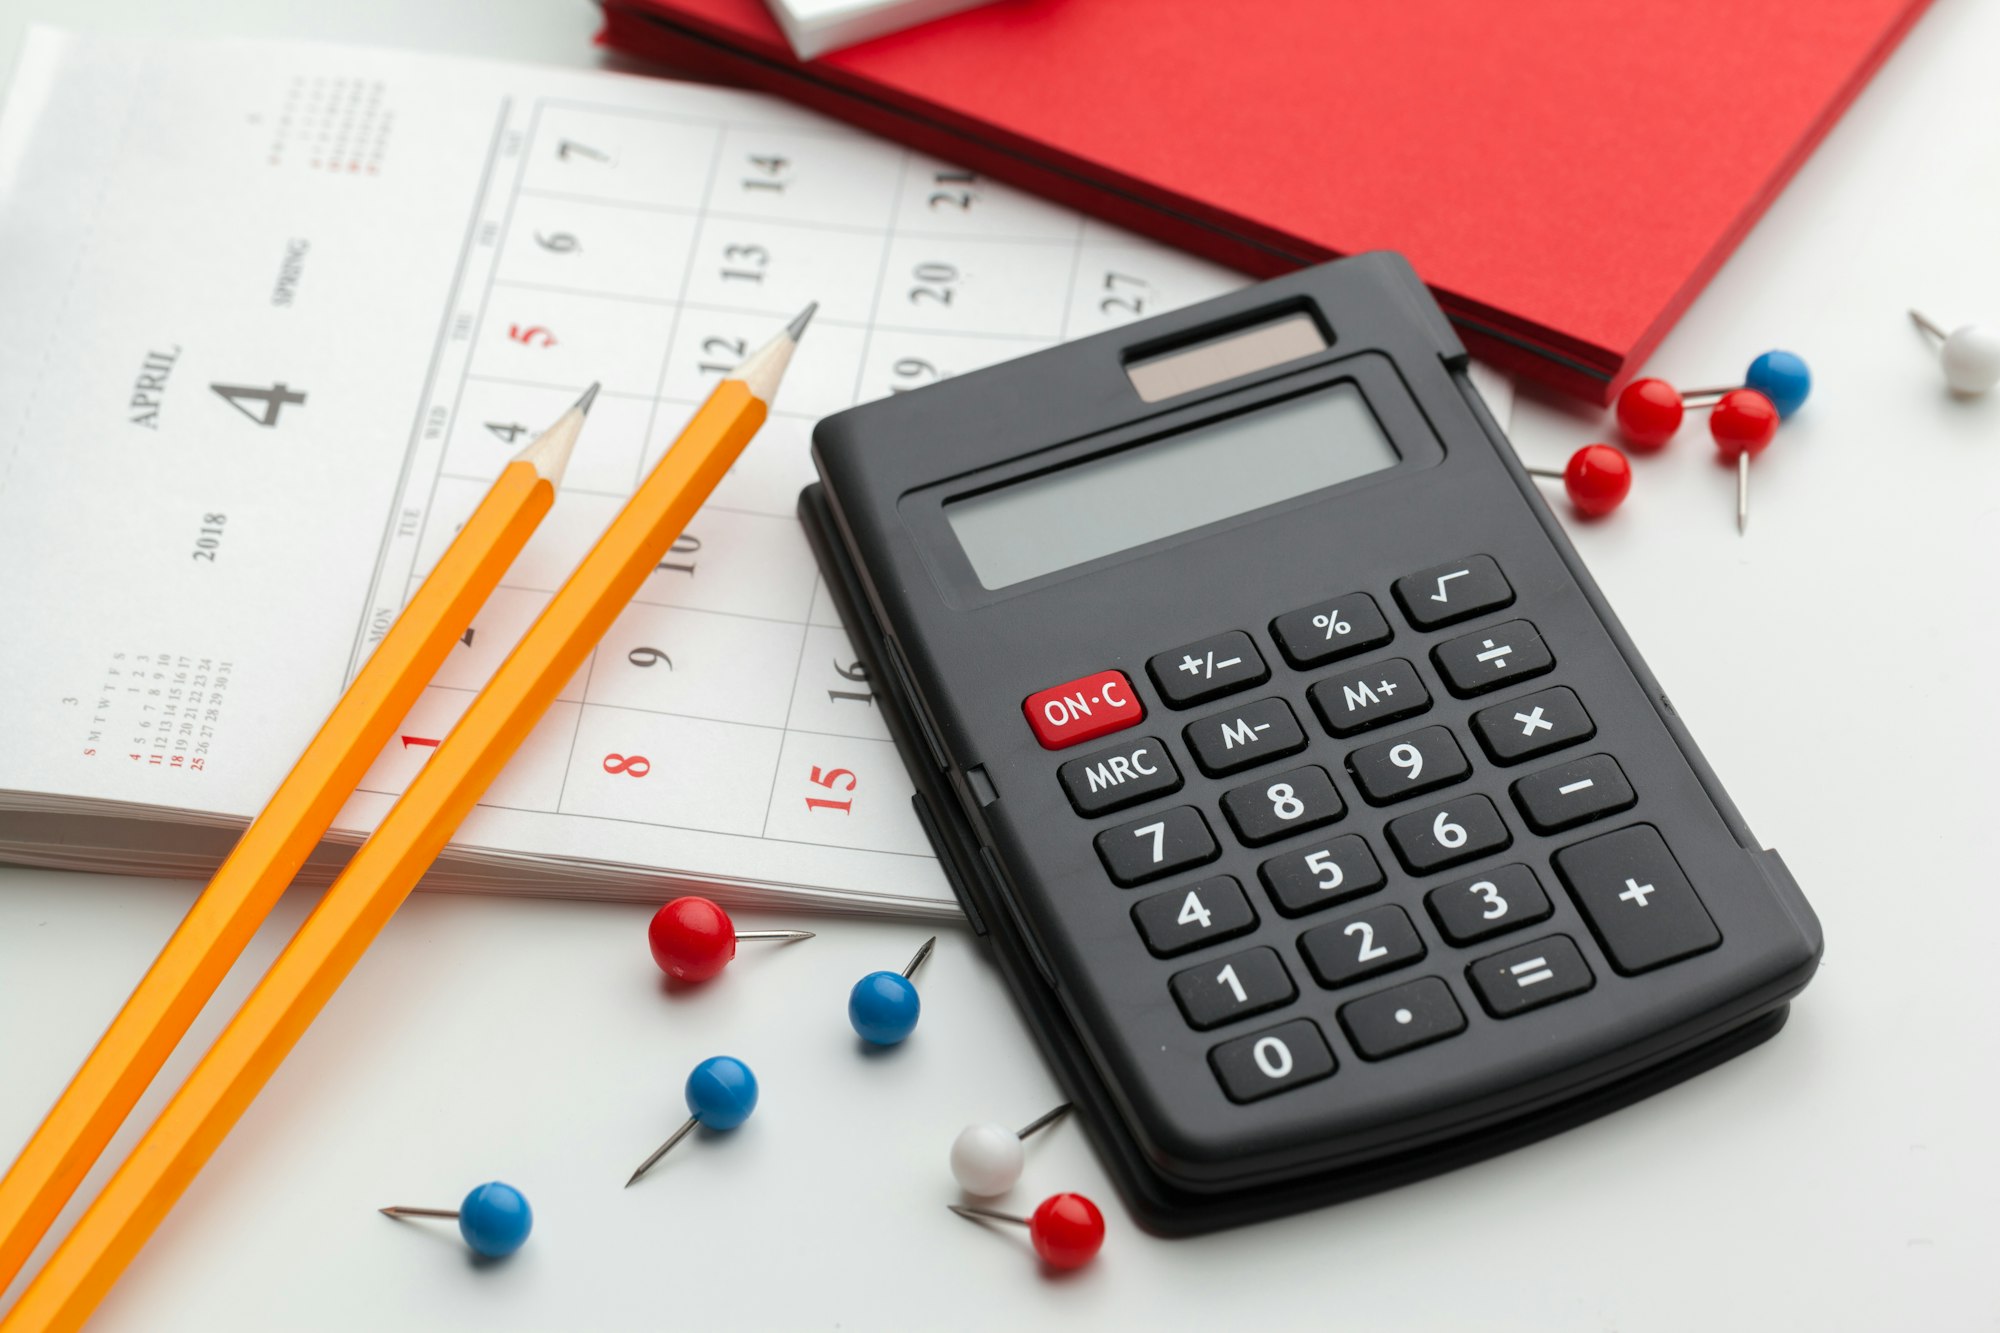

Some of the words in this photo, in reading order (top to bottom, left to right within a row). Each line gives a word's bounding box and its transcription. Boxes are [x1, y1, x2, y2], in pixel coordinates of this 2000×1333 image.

[556, 138, 610, 161] 7
[741, 154, 789, 195] 14
[928, 171, 977, 210] 21
[533, 229, 577, 255] 6
[720, 243, 769, 284] 13
[271, 237, 311, 307] SPRING
[908, 261, 957, 307] 20
[1099, 270, 1147, 315] 27
[509, 322, 558, 348] 5
[698, 335, 745, 375] 12
[129, 343, 182, 431] APRIL
[208, 381, 307, 429] 4
[483, 421, 527, 443] 4
[398, 507, 420, 538] TUE
[192, 511, 227, 563] 2018
[369, 608, 392, 643] MON
[1312, 610, 1351, 639] %
[137, 654, 149, 662] 3
[157, 653, 171, 666] 10
[178, 655, 192, 668] 17
[198, 658, 212, 671] 24
[628, 645, 674, 673] 9
[132, 670, 145, 678] 2
[219, 661, 233, 674] 31
[153, 672, 165, 680] 9
[173, 672, 187, 684] 16
[193, 675, 208, 687] 23
[104, 684, 116, 692] T
[214, 677, 228, 690] 30
[148, 688, 160, 696] 8
[168, 688, 182, 700] 15
[189, 691, 203, 703] 22
[1343, 680, 1397, 711] M+
[62, 697, 79, 706] 3
[98, 697, 111, 709] W
[209, 693, 223, 706] 29
[143, 704, 156, 712] 7
[163, 703, 177, 716] 14
[184, 707, 198, 720] 21
[94, 715, 106, 723] T
[205, 709, 219, 722] 28
[158, 720, 172, 732] 13
[179, 722, 194, 736] 20
[200, 725, 215, 738] 27
[88, 730, 102, 742] M
[154, 737, 168, 749] 12
[84, 748, 96, 756] S
[175, 739, 189, 752] 19
[195, 741, 210, 754] 26
[401, 735, 441, 761] 1
[129, 753, 141, 761] 4
[149, 754, 163, 765] 11
[170, 755, 184, 768] 18
[190, 757, 205, 771] 25
[1389, 743, 1423, 780] 9
[603, 752, 651, 779] 8
[1085, 749, 1157, 792] MRC
[805, 765, 857, 816] 15
[1267, 783, 1305, 820] 8
[1433, 811, 1467, 848] 6
[1134, 821, 1165, 863] 7
[1304, 849, 1343, 889] 5
[1469, 880, 1508, 920] 3
[1177, 891, 1211, 928] 4
[1343, 921, 1388, 963] 2
[1216, 964, 1249, 1003] 1
[1253, 1036, 1293, 1079] 0
